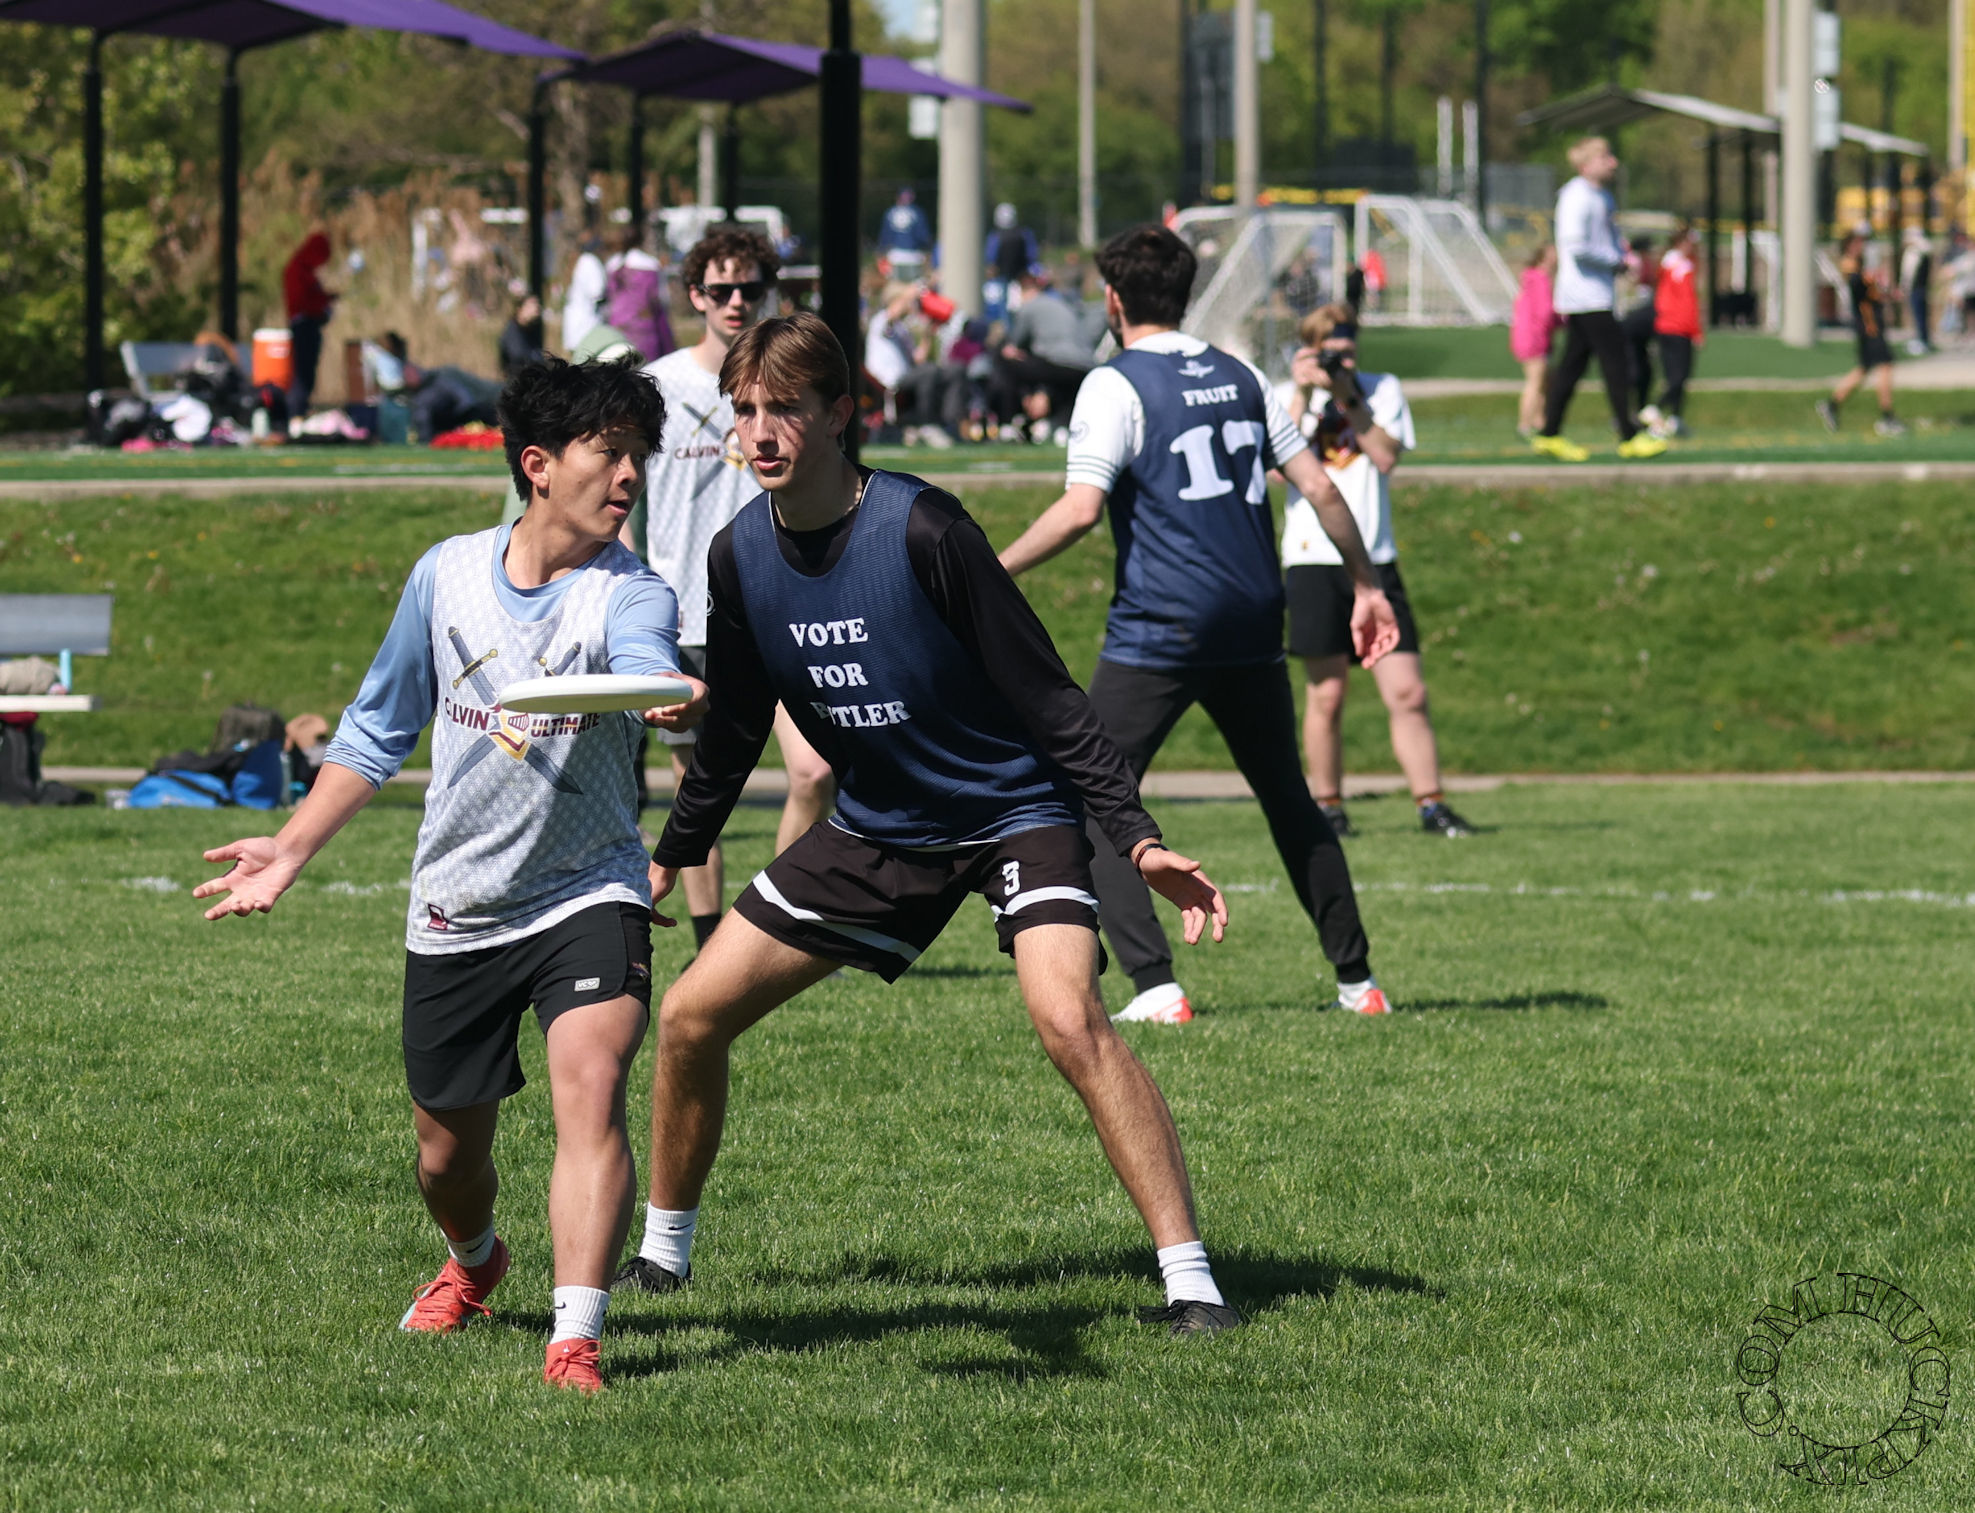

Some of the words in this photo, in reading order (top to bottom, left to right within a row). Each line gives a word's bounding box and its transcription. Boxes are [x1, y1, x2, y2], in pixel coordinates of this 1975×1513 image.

[1181, 384, 1238, 407] FRUIT
[674, 445, 720, 460] CALVIN
[1169, 419, 1266, 505] 17
[788, 617, 869, 647] VOTE
[807, 662, 869, 688] FOR
[531, 712, 600, 738] ULTIMATE
[809, 700, 912, 728] BTLER
[1001, 860, 1021, 896] 3
